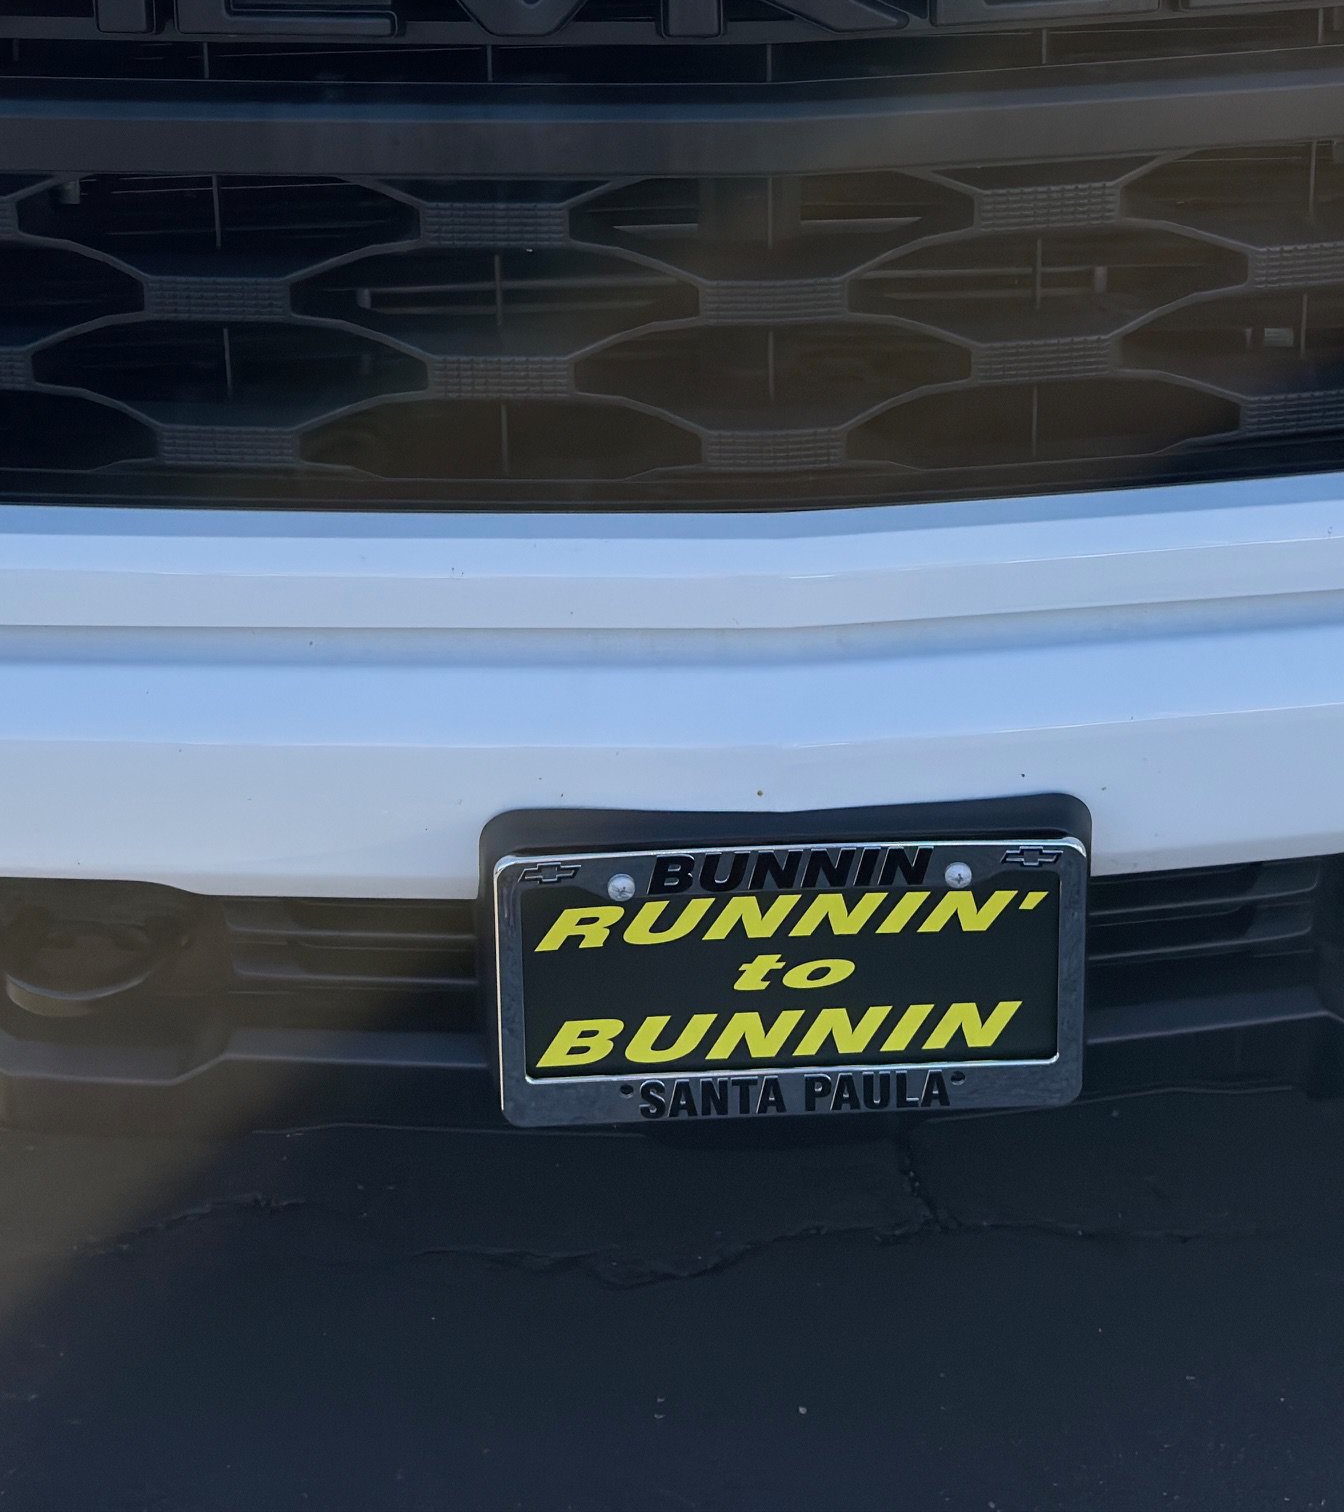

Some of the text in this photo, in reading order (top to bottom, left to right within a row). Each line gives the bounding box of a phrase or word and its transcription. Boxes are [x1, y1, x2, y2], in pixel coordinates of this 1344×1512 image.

[646, 845, 935, 895] BUNNIN
[534, 889, 1049, 953] RUNNIN'
[733, 953, 856, 991] to
[535, 1000, 1023, 1068] BUNNIN
[639, 1069, 951, 1120] SANTA PAULA
